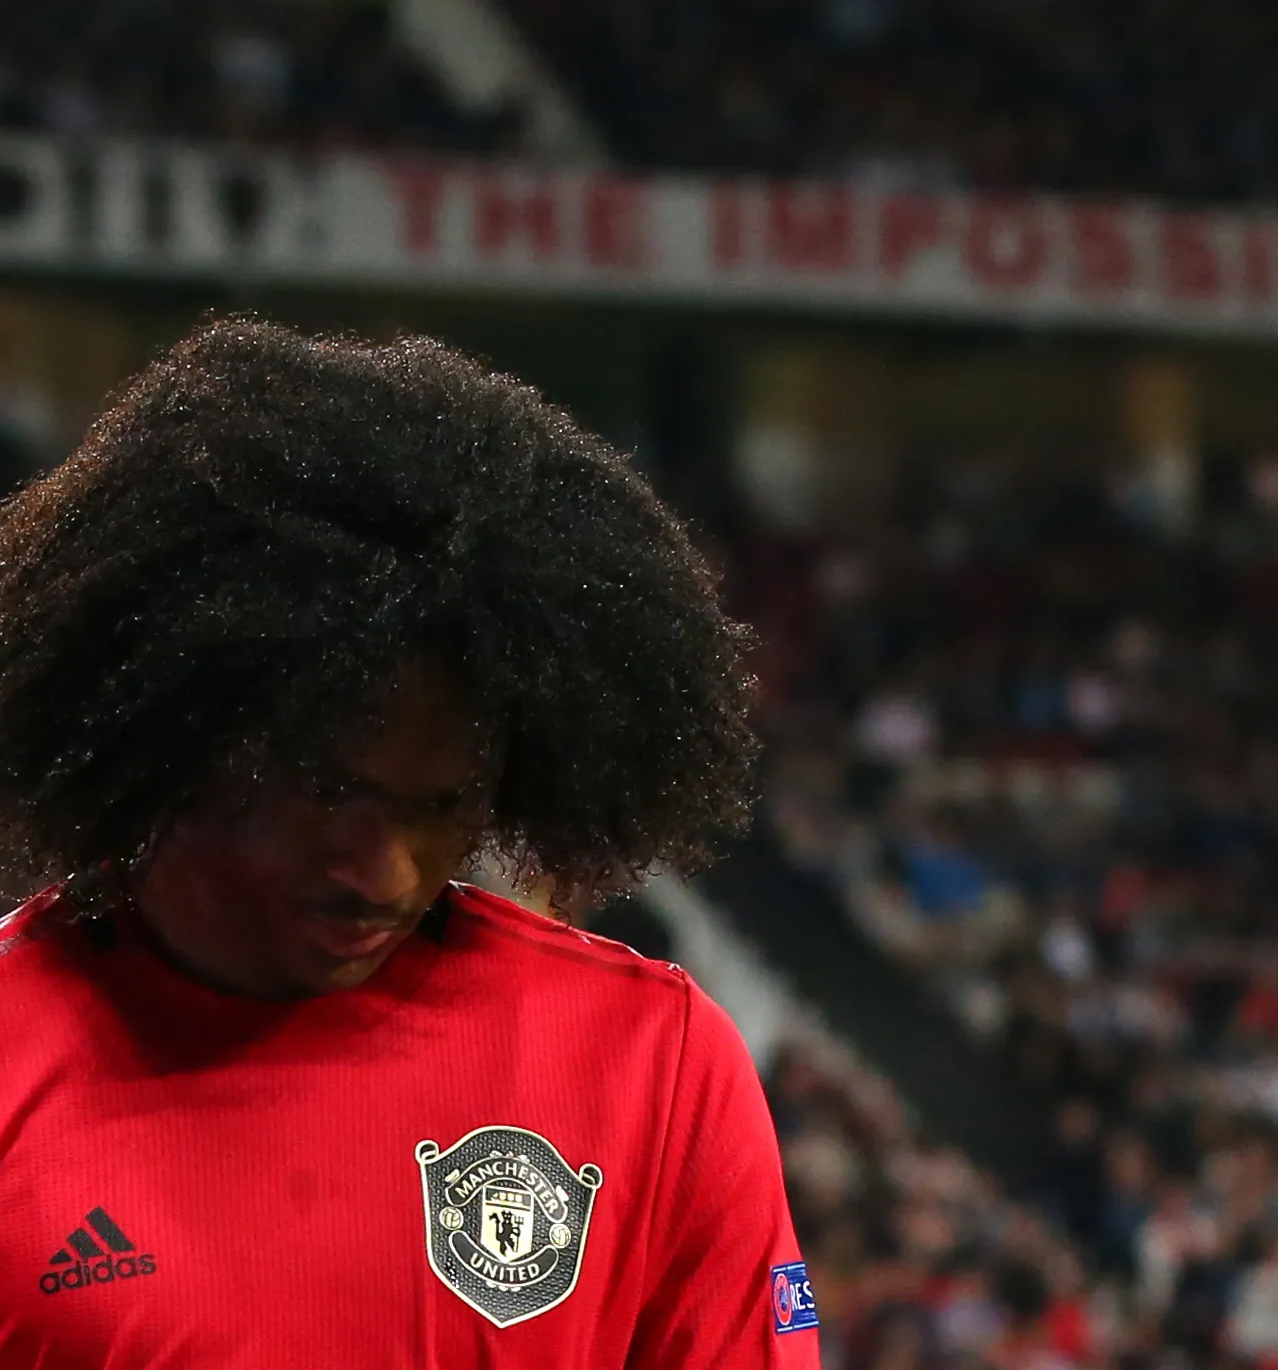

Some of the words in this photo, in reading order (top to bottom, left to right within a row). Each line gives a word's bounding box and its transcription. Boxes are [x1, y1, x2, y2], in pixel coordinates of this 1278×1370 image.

[384, 165, 651, 267] THE
[455, 1161, 560, 1213] MANCHESTER
[39, 1253, 157, 1295] adidas
[470, 1252, 540, 1283] UNITED
